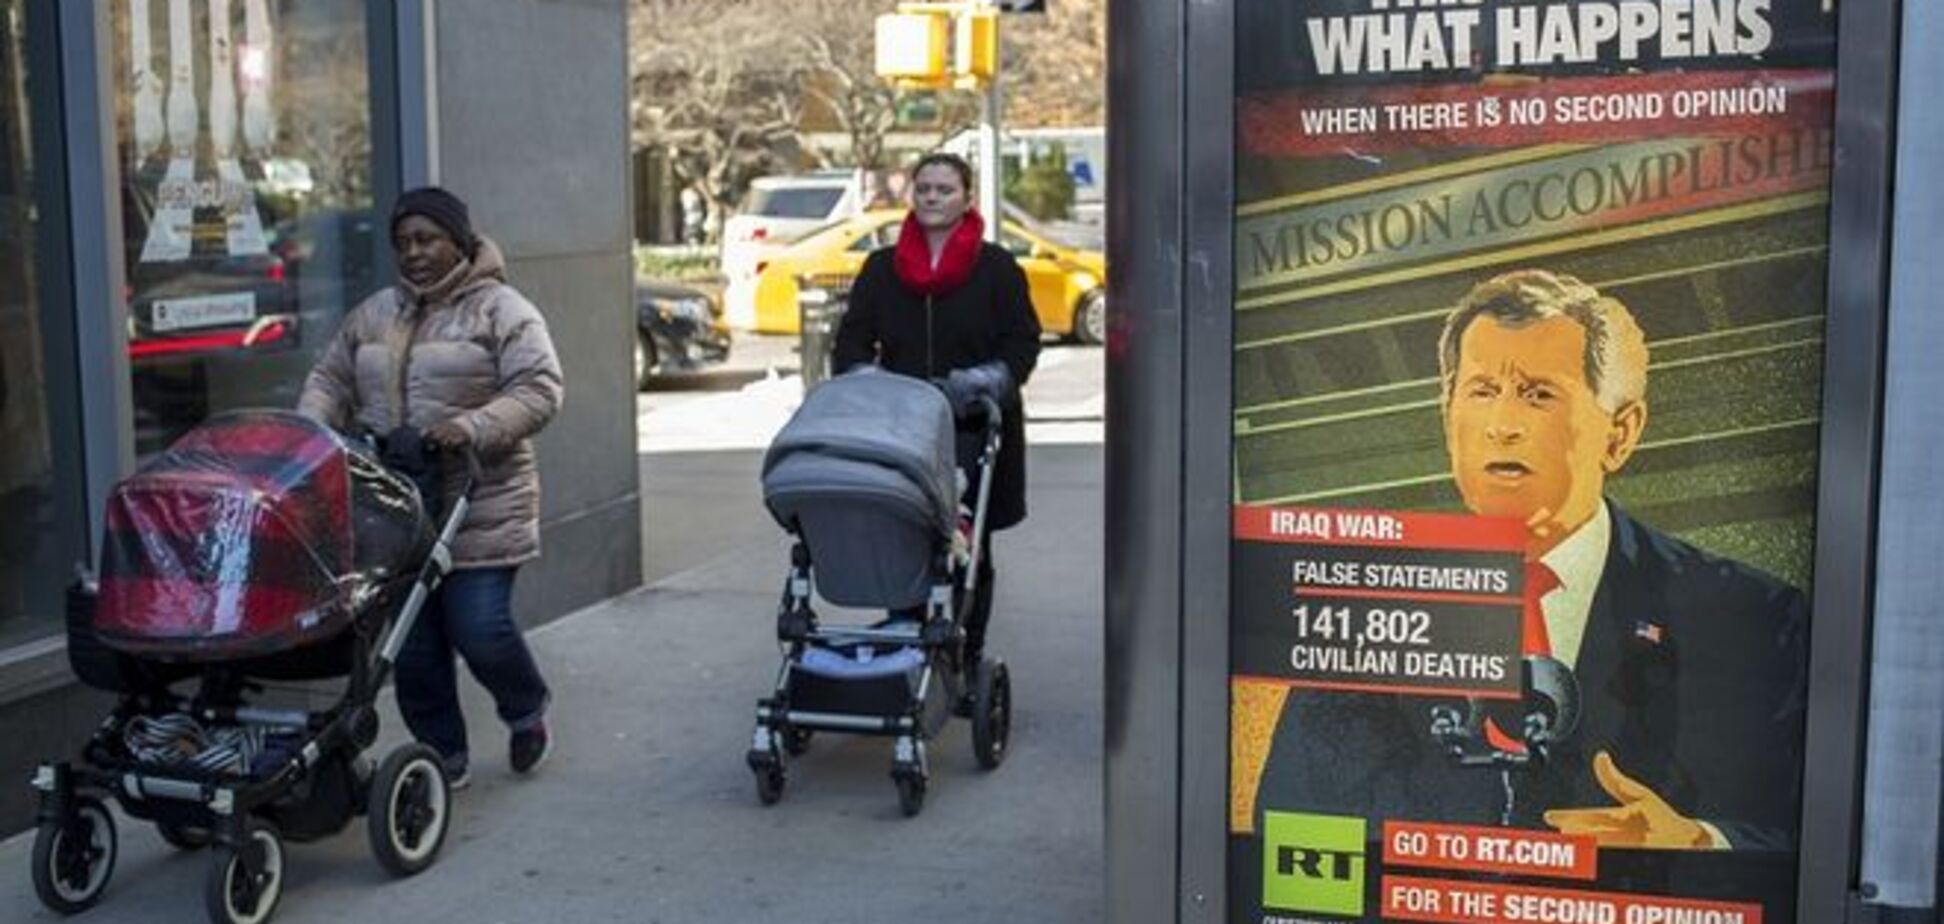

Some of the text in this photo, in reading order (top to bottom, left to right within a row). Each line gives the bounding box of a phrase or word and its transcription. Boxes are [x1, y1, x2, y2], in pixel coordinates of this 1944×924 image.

[1307, 0, 1772, 75] WHAT HAPPENS
[1301, 87, 1786, 135] WHEN THERE IS NO SECOND OPINION
[1250, 194, 1453, 278] MISSION
[1271, 511, 1404, 540] IRAQ WAR:
[1293, 561, 1508, 593] FALSE STATEMENTS
[1293, 605, 1431, 648] 141,802
[1291, 644, 1396, 676] CIVILIAN
[1277, 845, 1367, 881] RT
[1393, 831, 1576, 868] GO TO RT.COM
[1392, 886, 1440, 913] FOR
[1448, 891, 1496, 917] THE
[1504, 894, 1617, 924] SECOND
